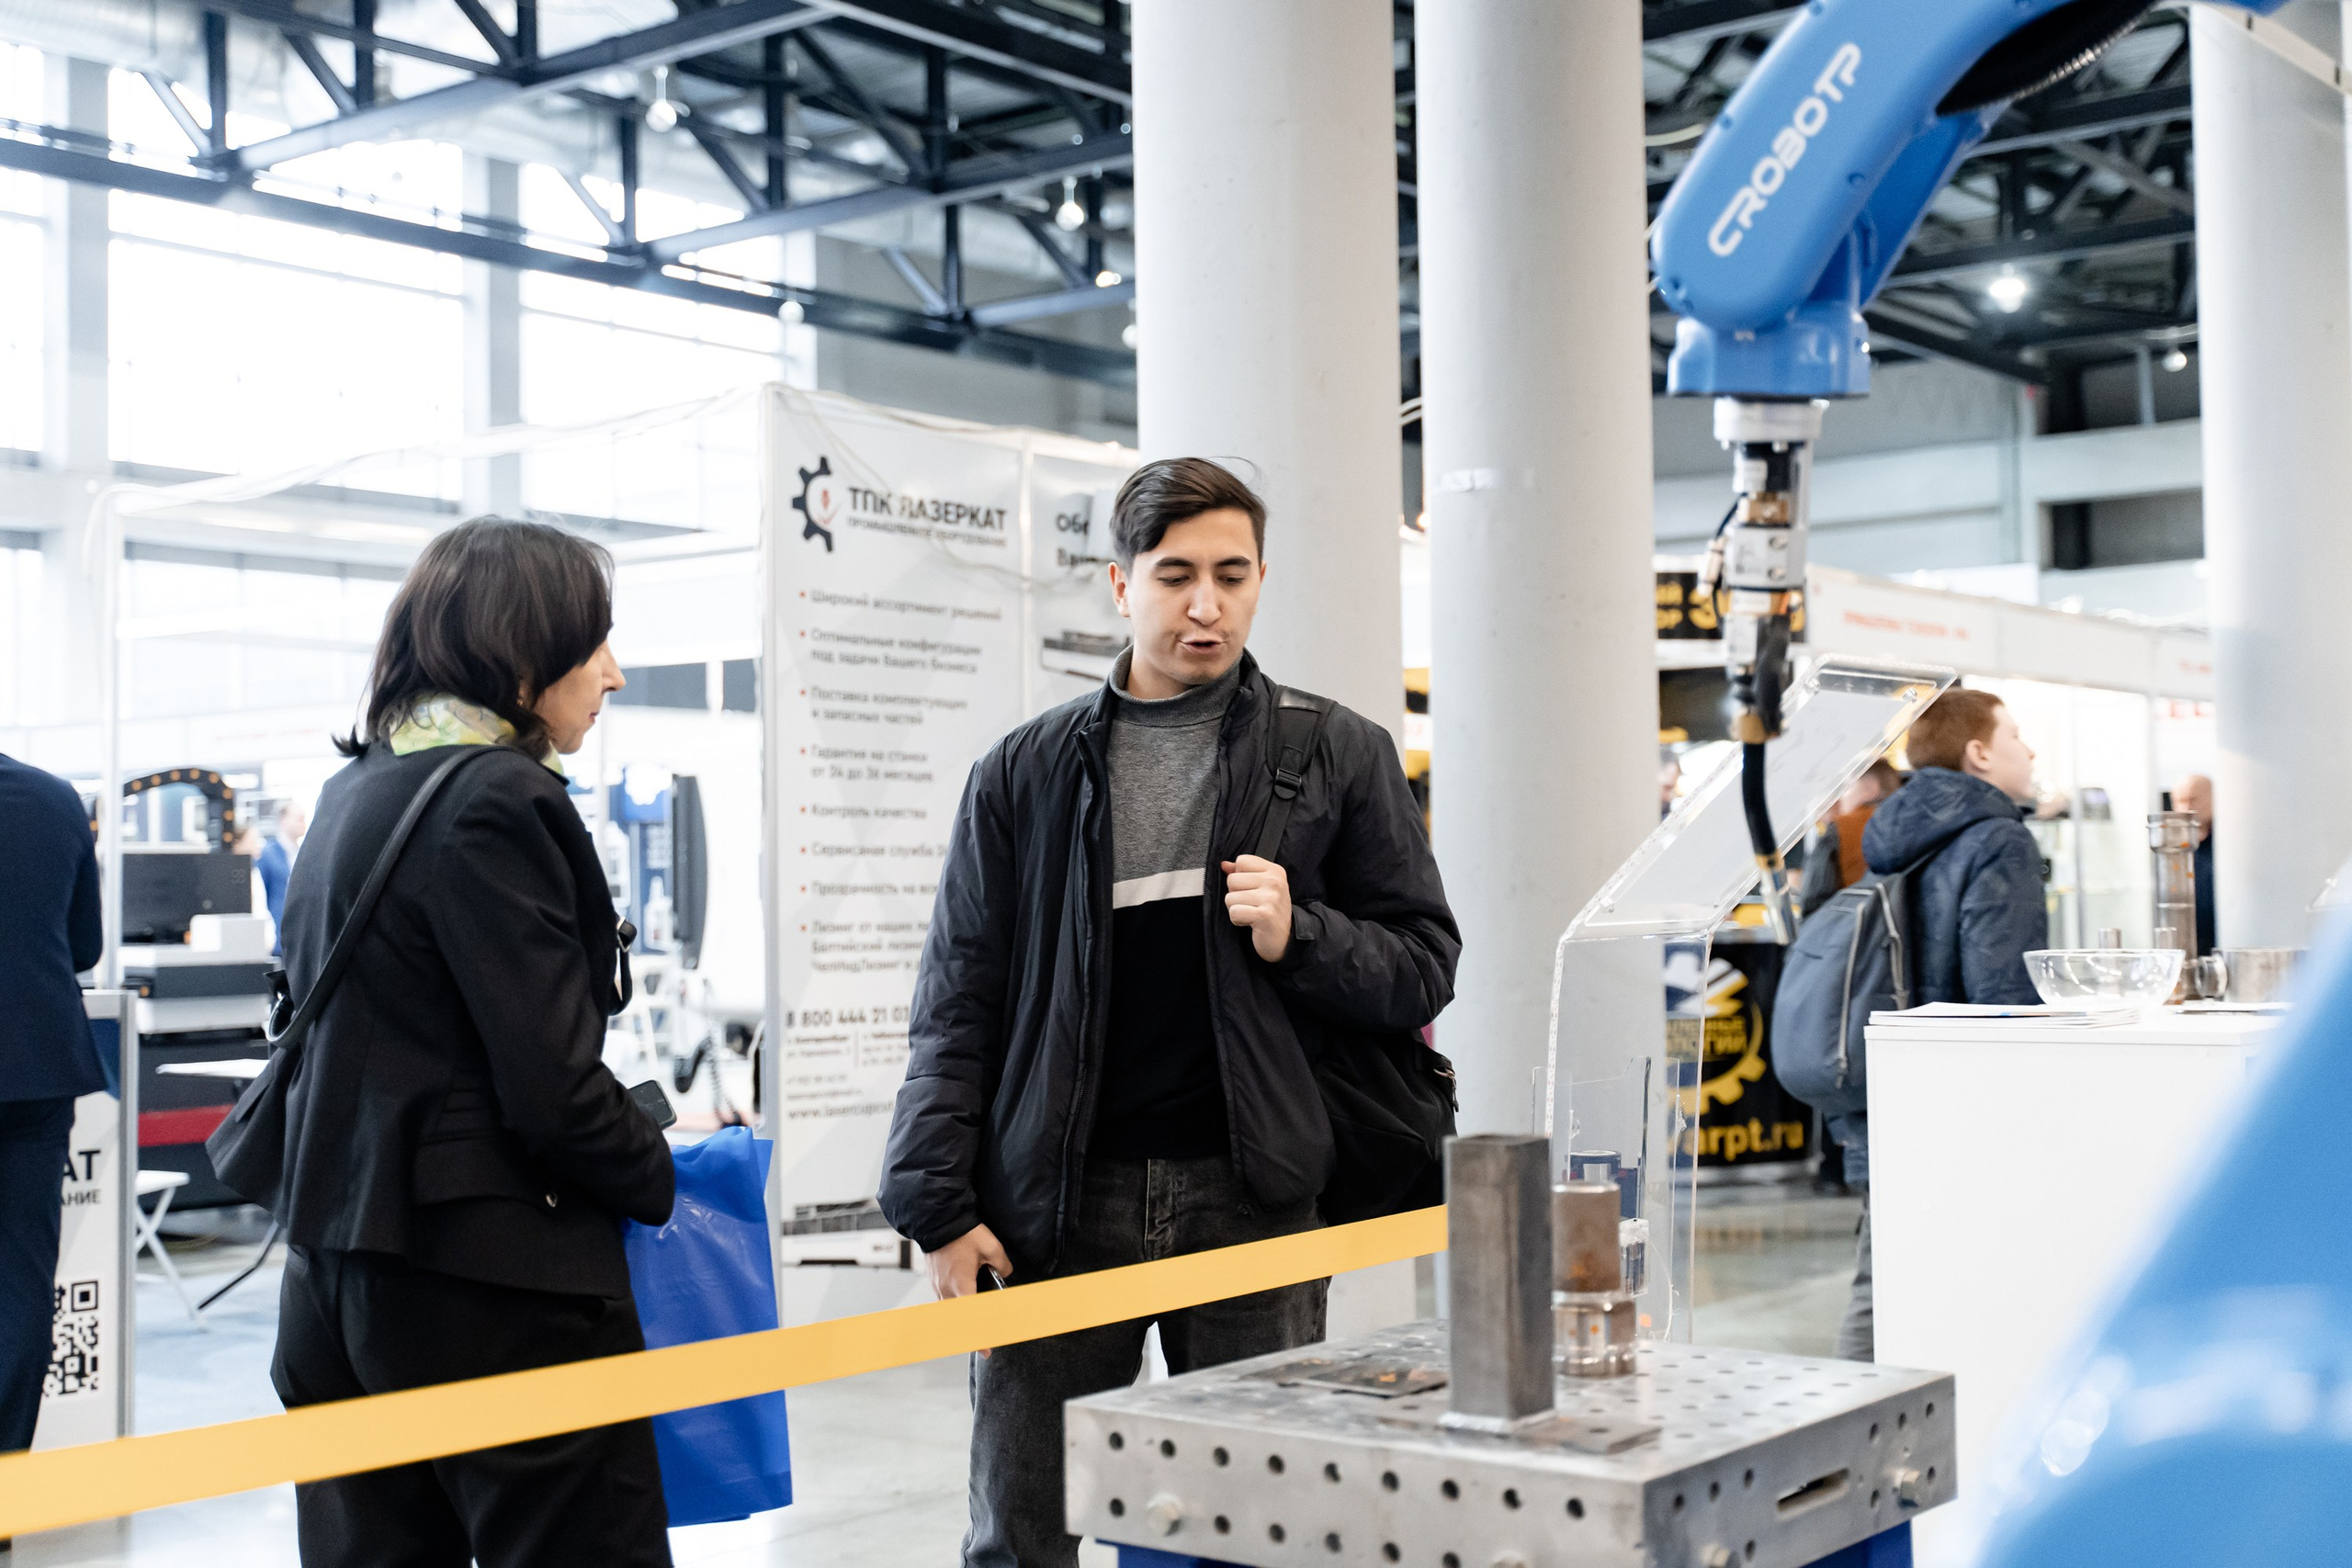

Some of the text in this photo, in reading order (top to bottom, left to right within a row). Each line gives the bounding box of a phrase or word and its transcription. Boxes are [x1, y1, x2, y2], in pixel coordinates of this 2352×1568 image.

[1708, 42, 1861, 257] CROBOTP
[848, 484, 1008, 531] ТПК ЛАЗЕРКАТ
[810, 588, 869, 607] Широкий
[873, 597, 947, 615] ассортимент
[810, 626, 895, 648] Оптимальные
[810, 685, 869, 704] Поставка
[811, 743, 867, 761] Гарантия
[811, 802, 871, 820] Контроль
[786, 1010, 795, 1028] 8
[800, 1008, 833, 1028] 800
[838, 1006, 867, 1024] 444
